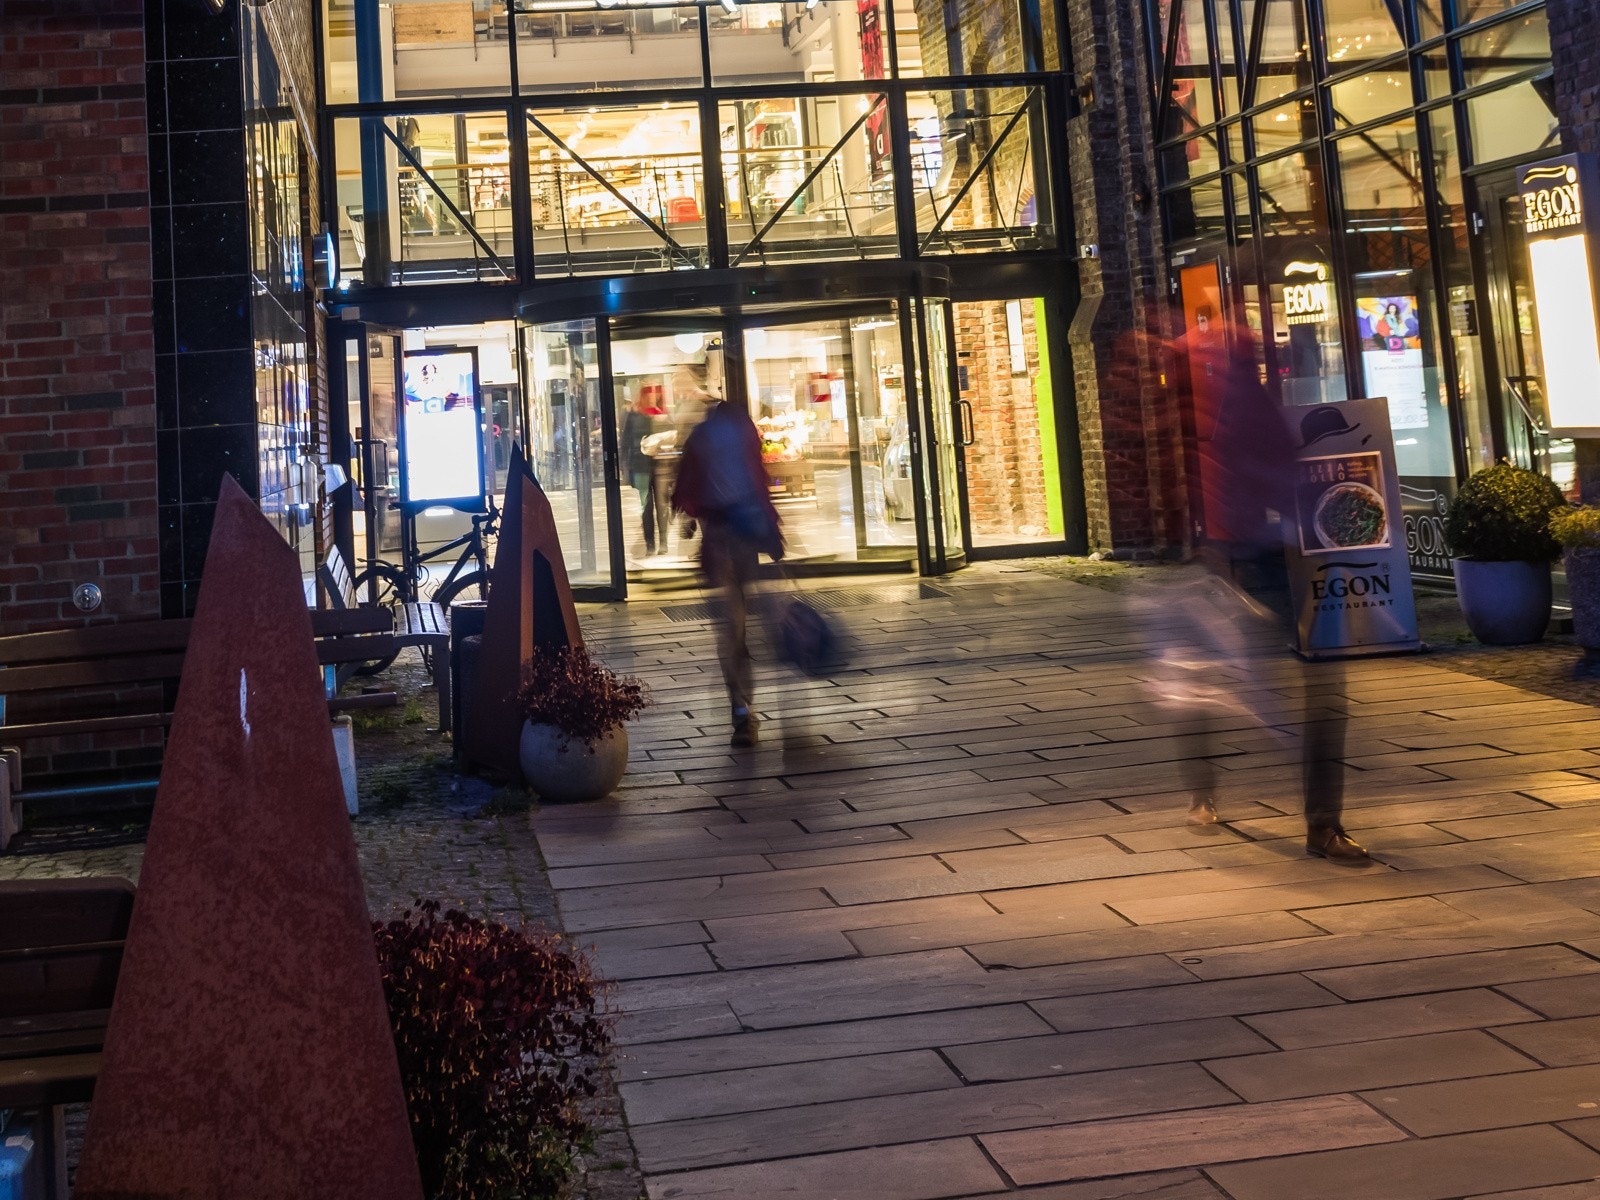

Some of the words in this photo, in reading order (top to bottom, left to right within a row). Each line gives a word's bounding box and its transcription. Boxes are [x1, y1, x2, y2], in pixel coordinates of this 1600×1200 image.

[1522, 183, 1581, 222] EGON
[1526, 213, 1581, 233] RESTAURANT
[1283, 281, 1328, 314] EGON
[1287, 313, 1328, 325] RESTAURANT
[1311, 574, 1390, 600] EGON
[1313, 599, 1394, 612] RESTAURANT
